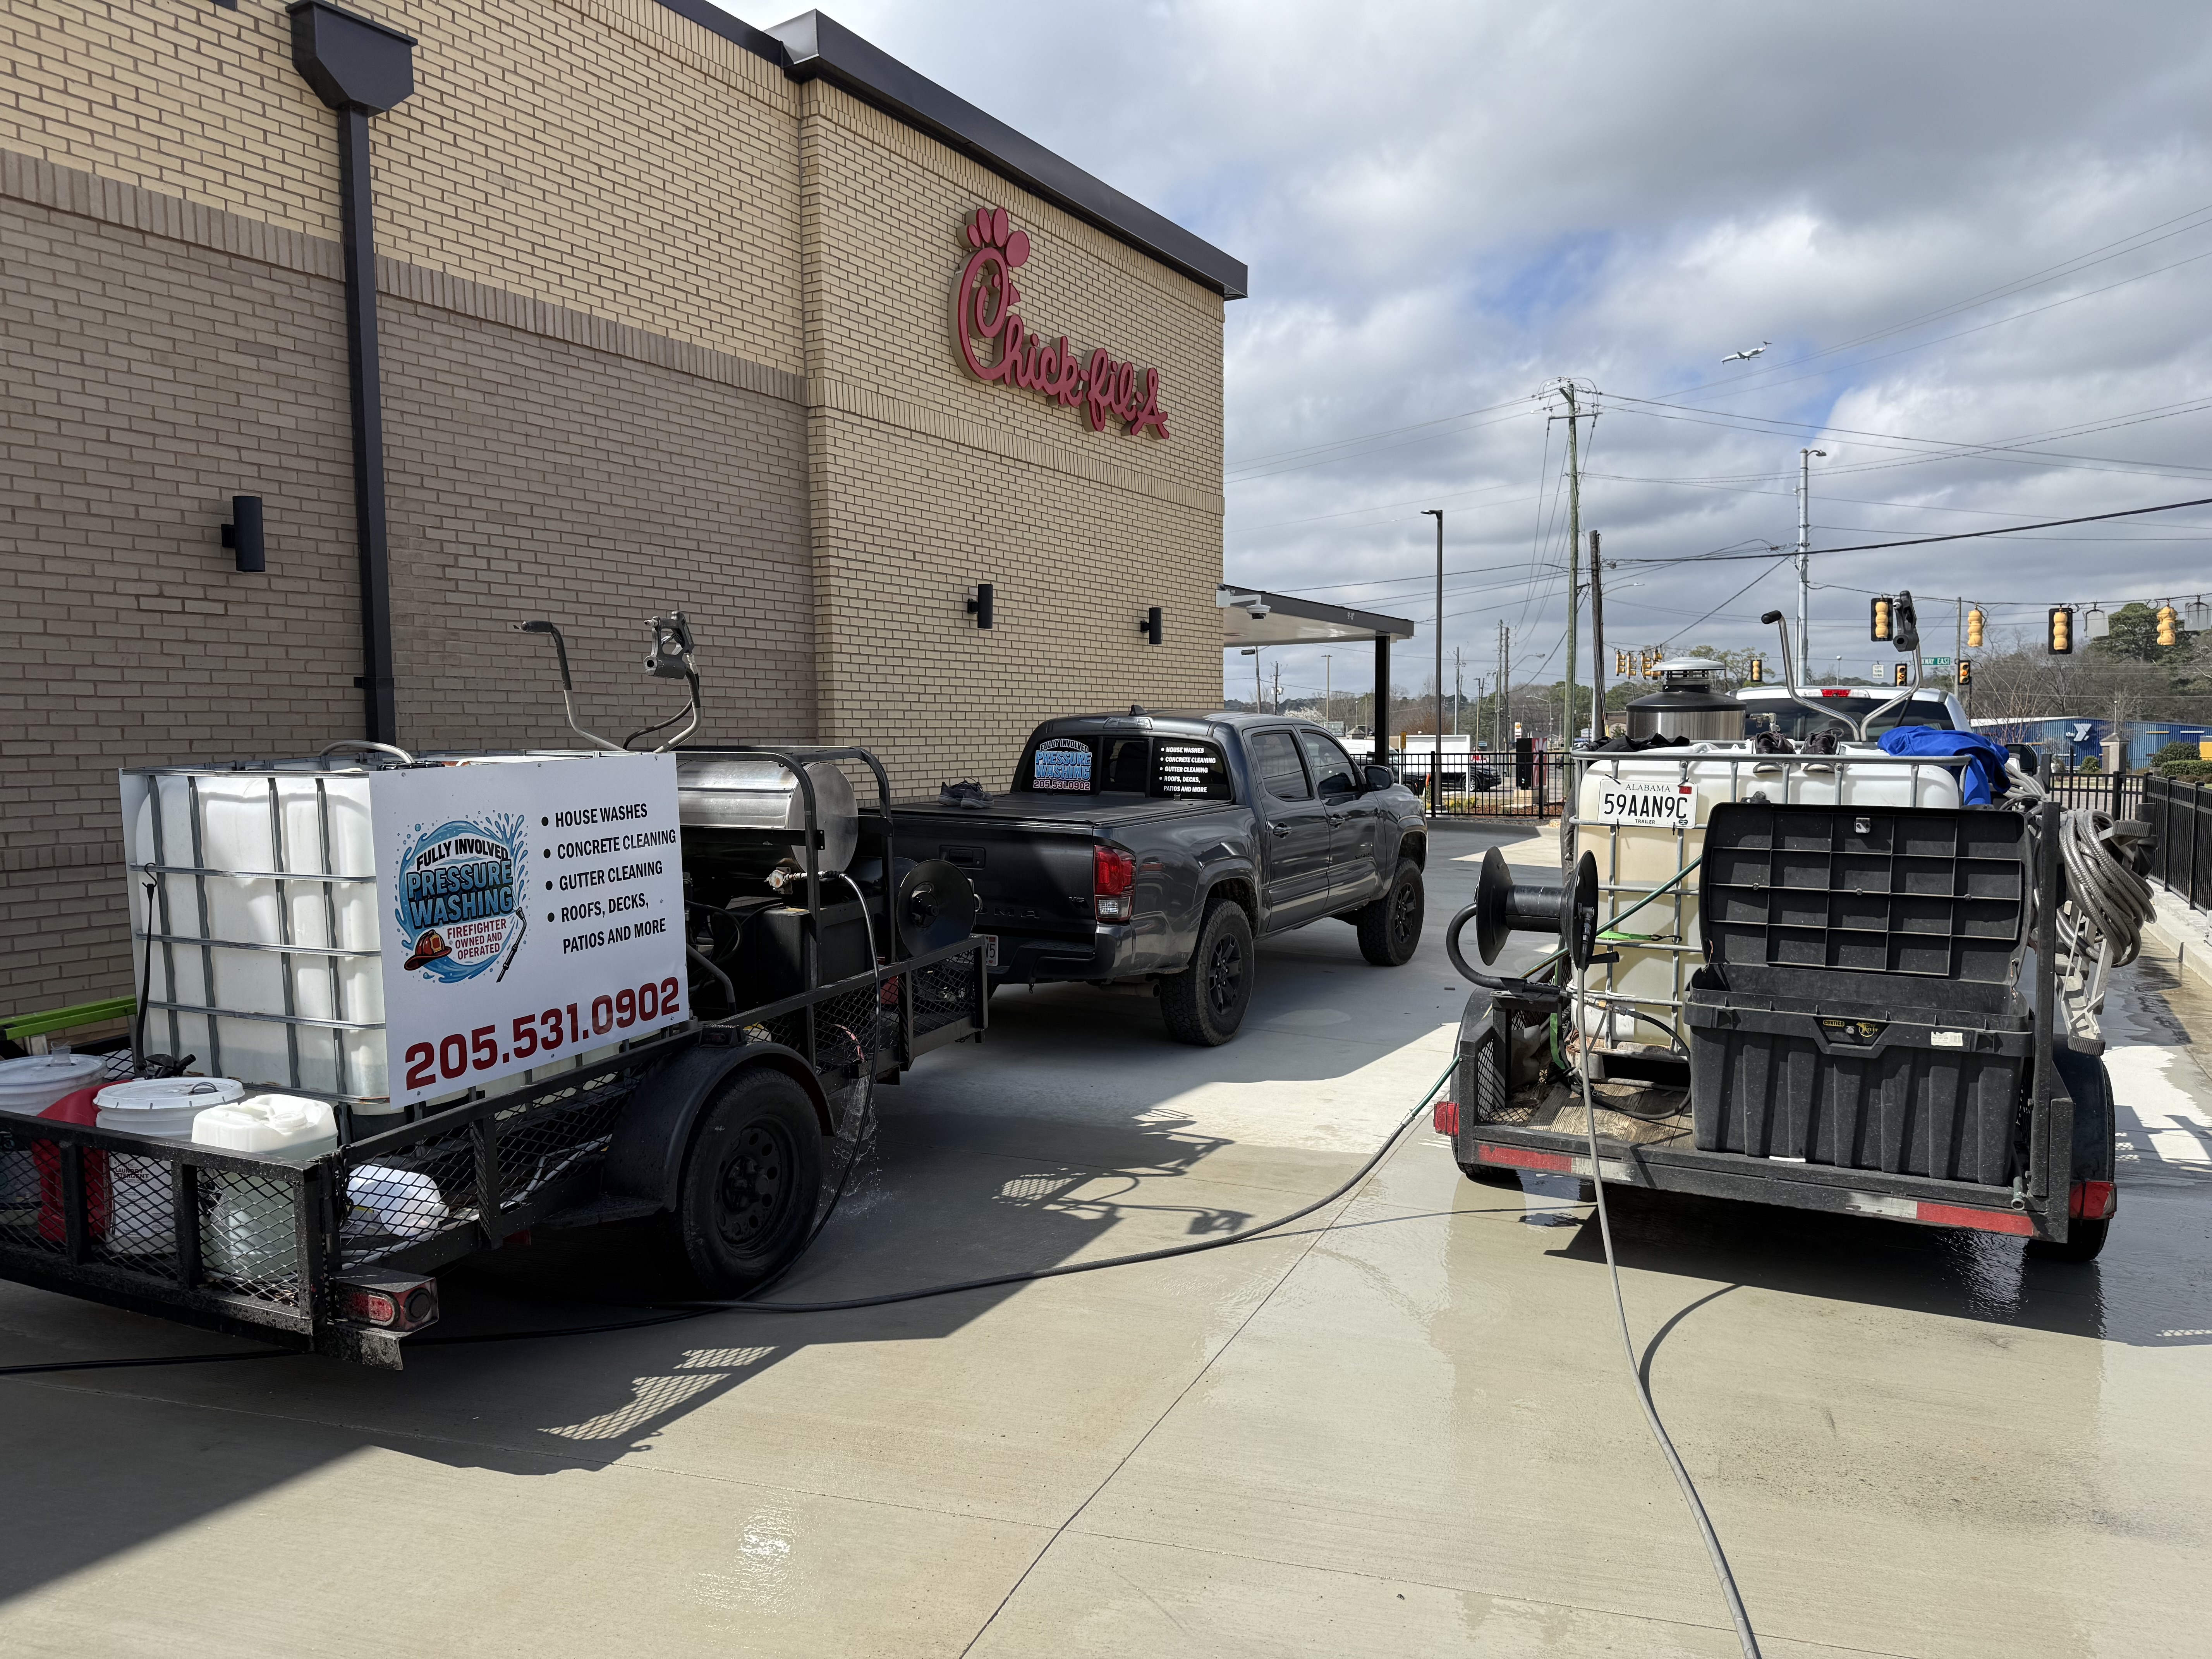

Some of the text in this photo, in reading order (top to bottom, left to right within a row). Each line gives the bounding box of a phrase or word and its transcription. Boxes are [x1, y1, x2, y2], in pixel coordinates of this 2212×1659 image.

[1035, 750, 1092, 766] PRESSURE
[1040, 738, 1089, 753] FULLY INVOLVED
[1033, 780, 1091, 790] 205.531.0902
[1035, 764, 1091, 781] WASHING
[1625, 784, 1670, 792] ALABAMA
[555, 803, 647, 828] HOUSE WASHES
[1604, 793, 1688, 819] 59AAN9C
[416, 838, 508, 871] FULLY INVOLVED
[557, 829, 676, 859] CONCRETE CLEANING
[407, 858, 513, 901] PRESSURE
[559, 860, 663, 891] GUTTER CLEANING
[410, 886, 514, 929] WASHING
[561, 892, 649, 923] ROOFS, DECKS,
[447, 918, 507, 940] FIREFIGHTER
[455, 931, 503, 950] OWNED AND
[563, 918, 666, 954] PATIOS AND MORE
[457, 943, 500, 960] OPERATED
[405, 977, 680, 1090] 205.531.0902
